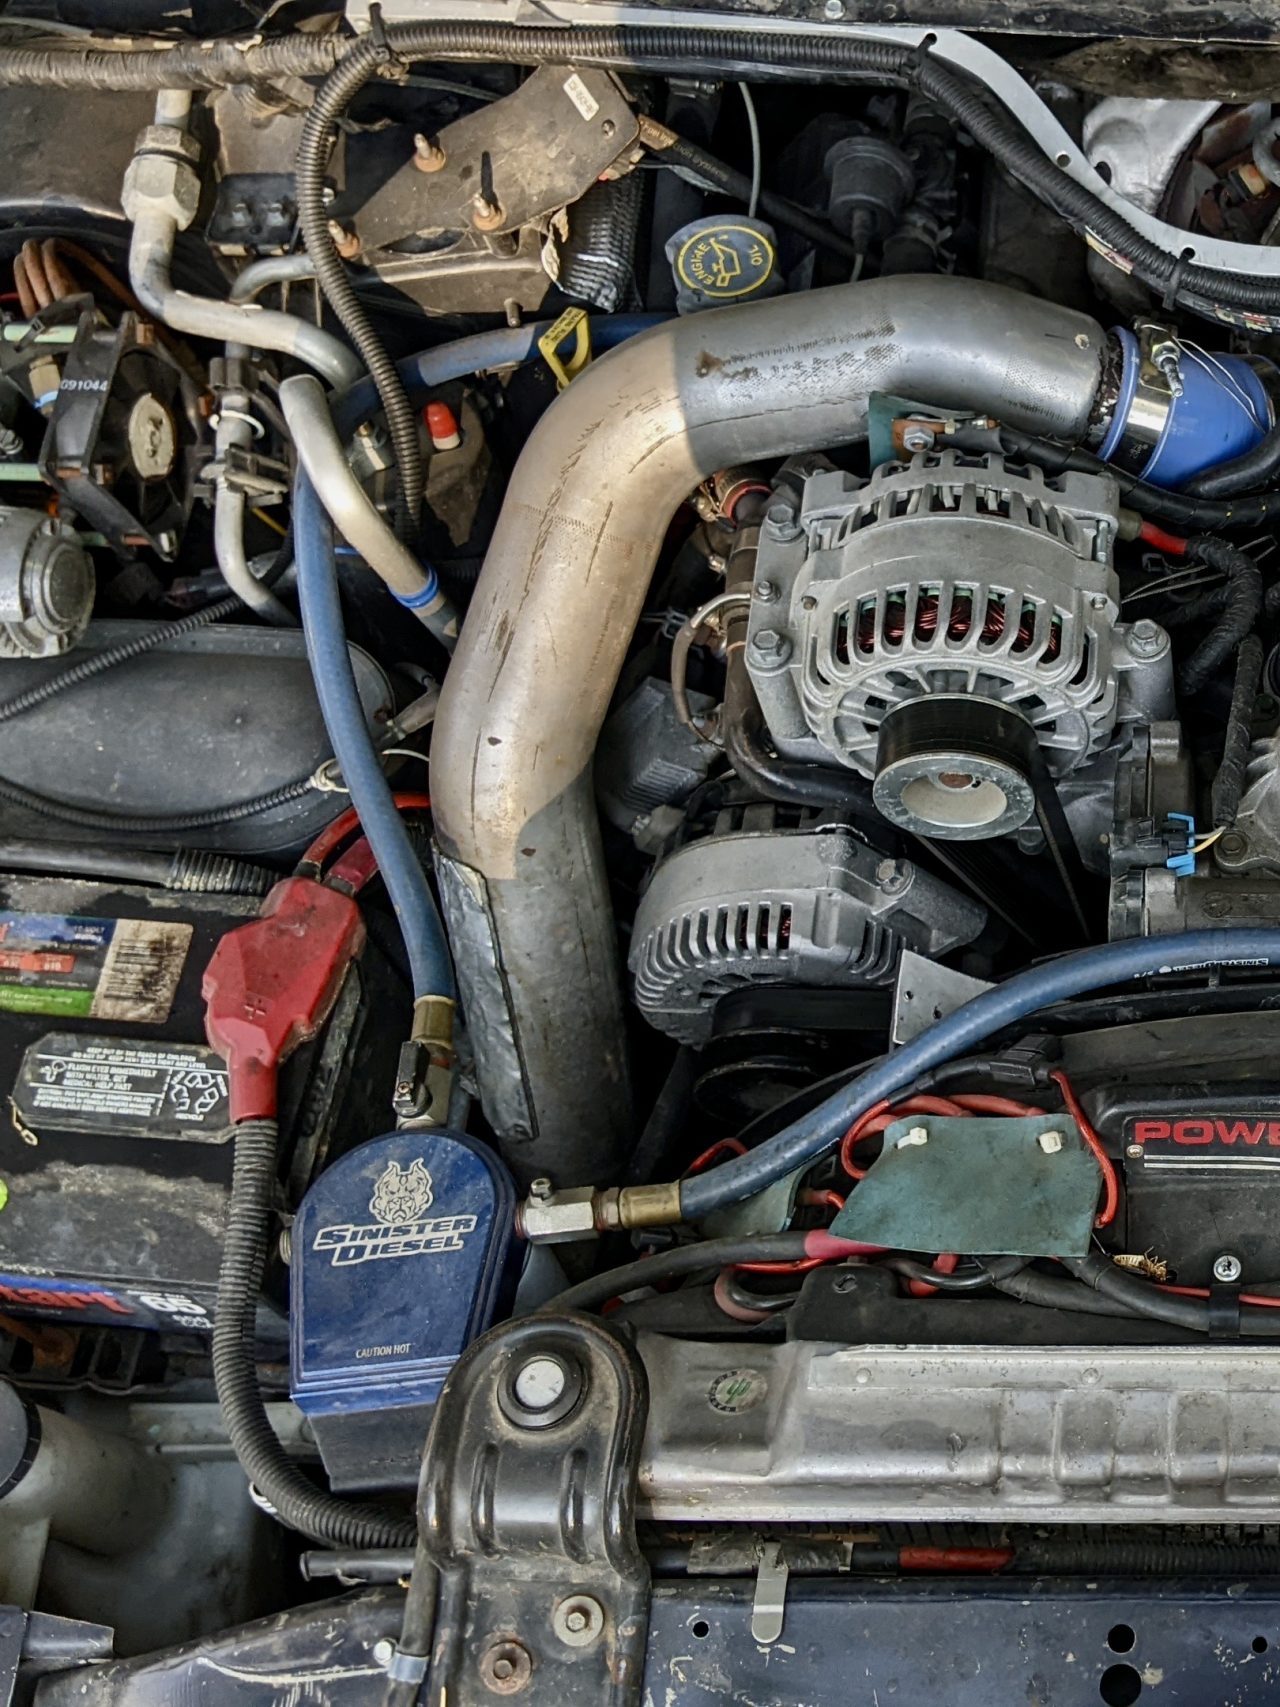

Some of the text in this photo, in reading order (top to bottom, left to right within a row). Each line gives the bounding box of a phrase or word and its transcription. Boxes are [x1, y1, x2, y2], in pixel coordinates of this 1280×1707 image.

[691, 242, 763, 285] ENGINE OIL
[66, 1062, 90, 1071] FLUSH
[313, 1215, 478, 1250] SINISTER
[331, 1233, 465, 1267] DIESEL
[139, 1295, 207, 1315] 65
[356, 1343, 411, 1359] CAUTION HOT
